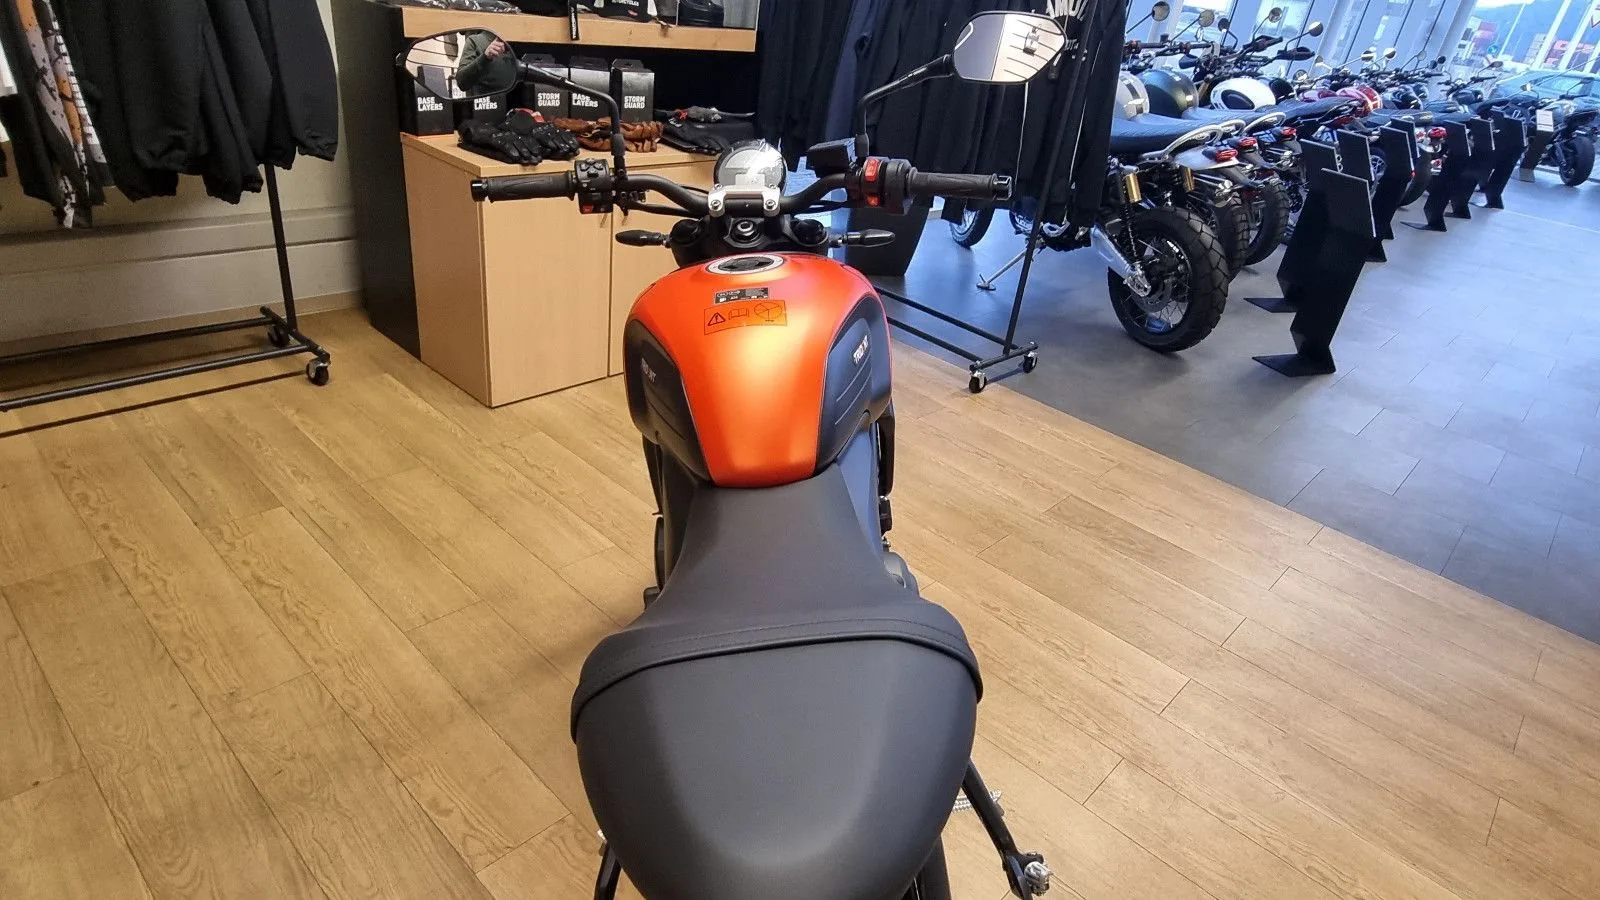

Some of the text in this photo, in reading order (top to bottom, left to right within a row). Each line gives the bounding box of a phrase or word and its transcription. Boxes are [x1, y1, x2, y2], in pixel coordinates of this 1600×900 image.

[474, 96, 491, 104] BASE
[572, 93, 590, 101] BASE
[417, 103, 443, 111] LAYERS
[474, 102, 498, 110] LAYERS
